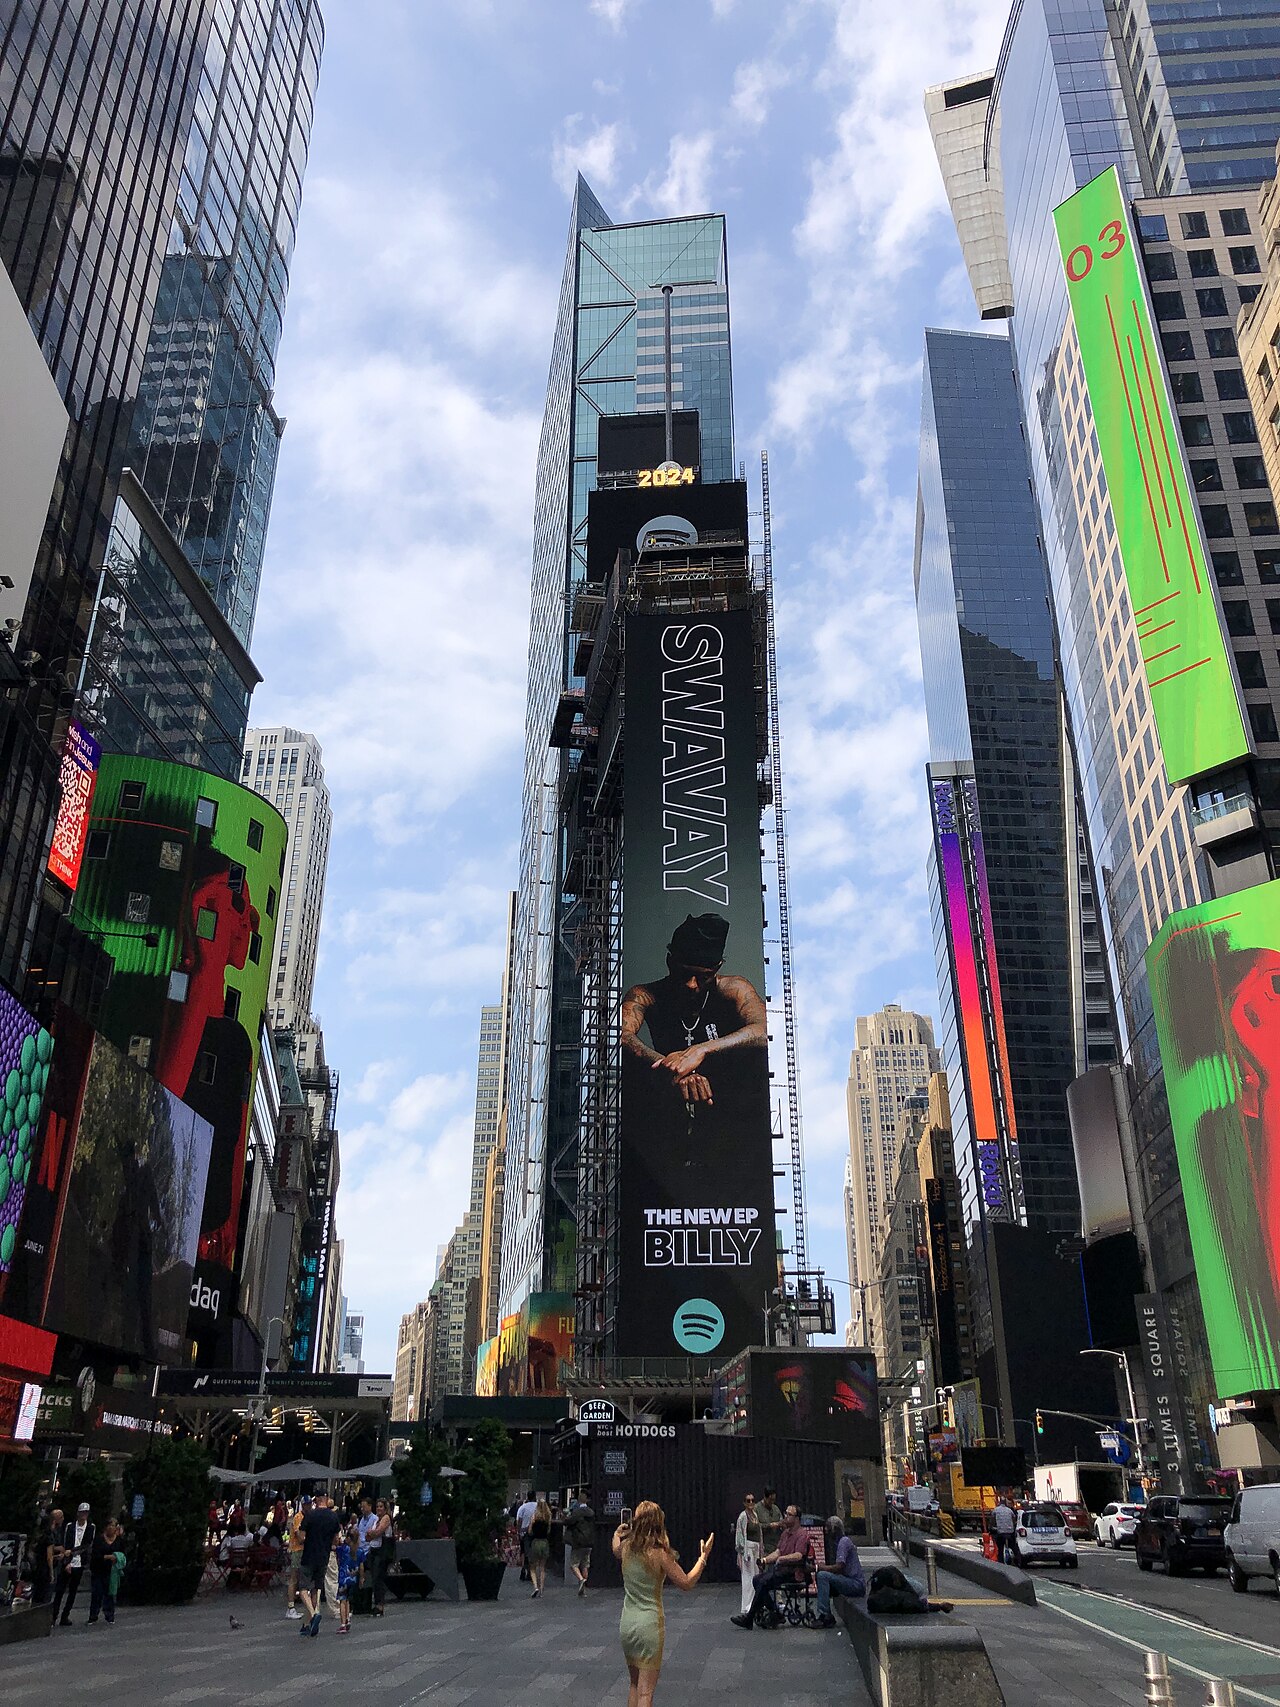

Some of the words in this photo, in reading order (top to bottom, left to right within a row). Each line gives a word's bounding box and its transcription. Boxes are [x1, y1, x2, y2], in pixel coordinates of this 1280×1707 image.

[638, 467, 696, 487] 2024
[660, 624, 729, 906] SWAVAY
[978, 1145, 1002, 1207] ROKU
[643, 1208, 682, 1225] THE
[683, 1208, 732, 1225] NEW
[734, 1207, 759, 1224] EP
[24, 1239, 38, 1253] JUNE
[644, 1228, 762, 1267] BILLY
[1143, 1307, 1164, 1376] SQUARE
[582, 1412, 611, 1420] GARDEN
[588, 1402, 606, 1411] BEER
[615, 1424, 676, 1437] HOTDOGS
[1157, 1396, 1177, 1451] TIMES
[1167, 1462, 1179, 1472] 3
